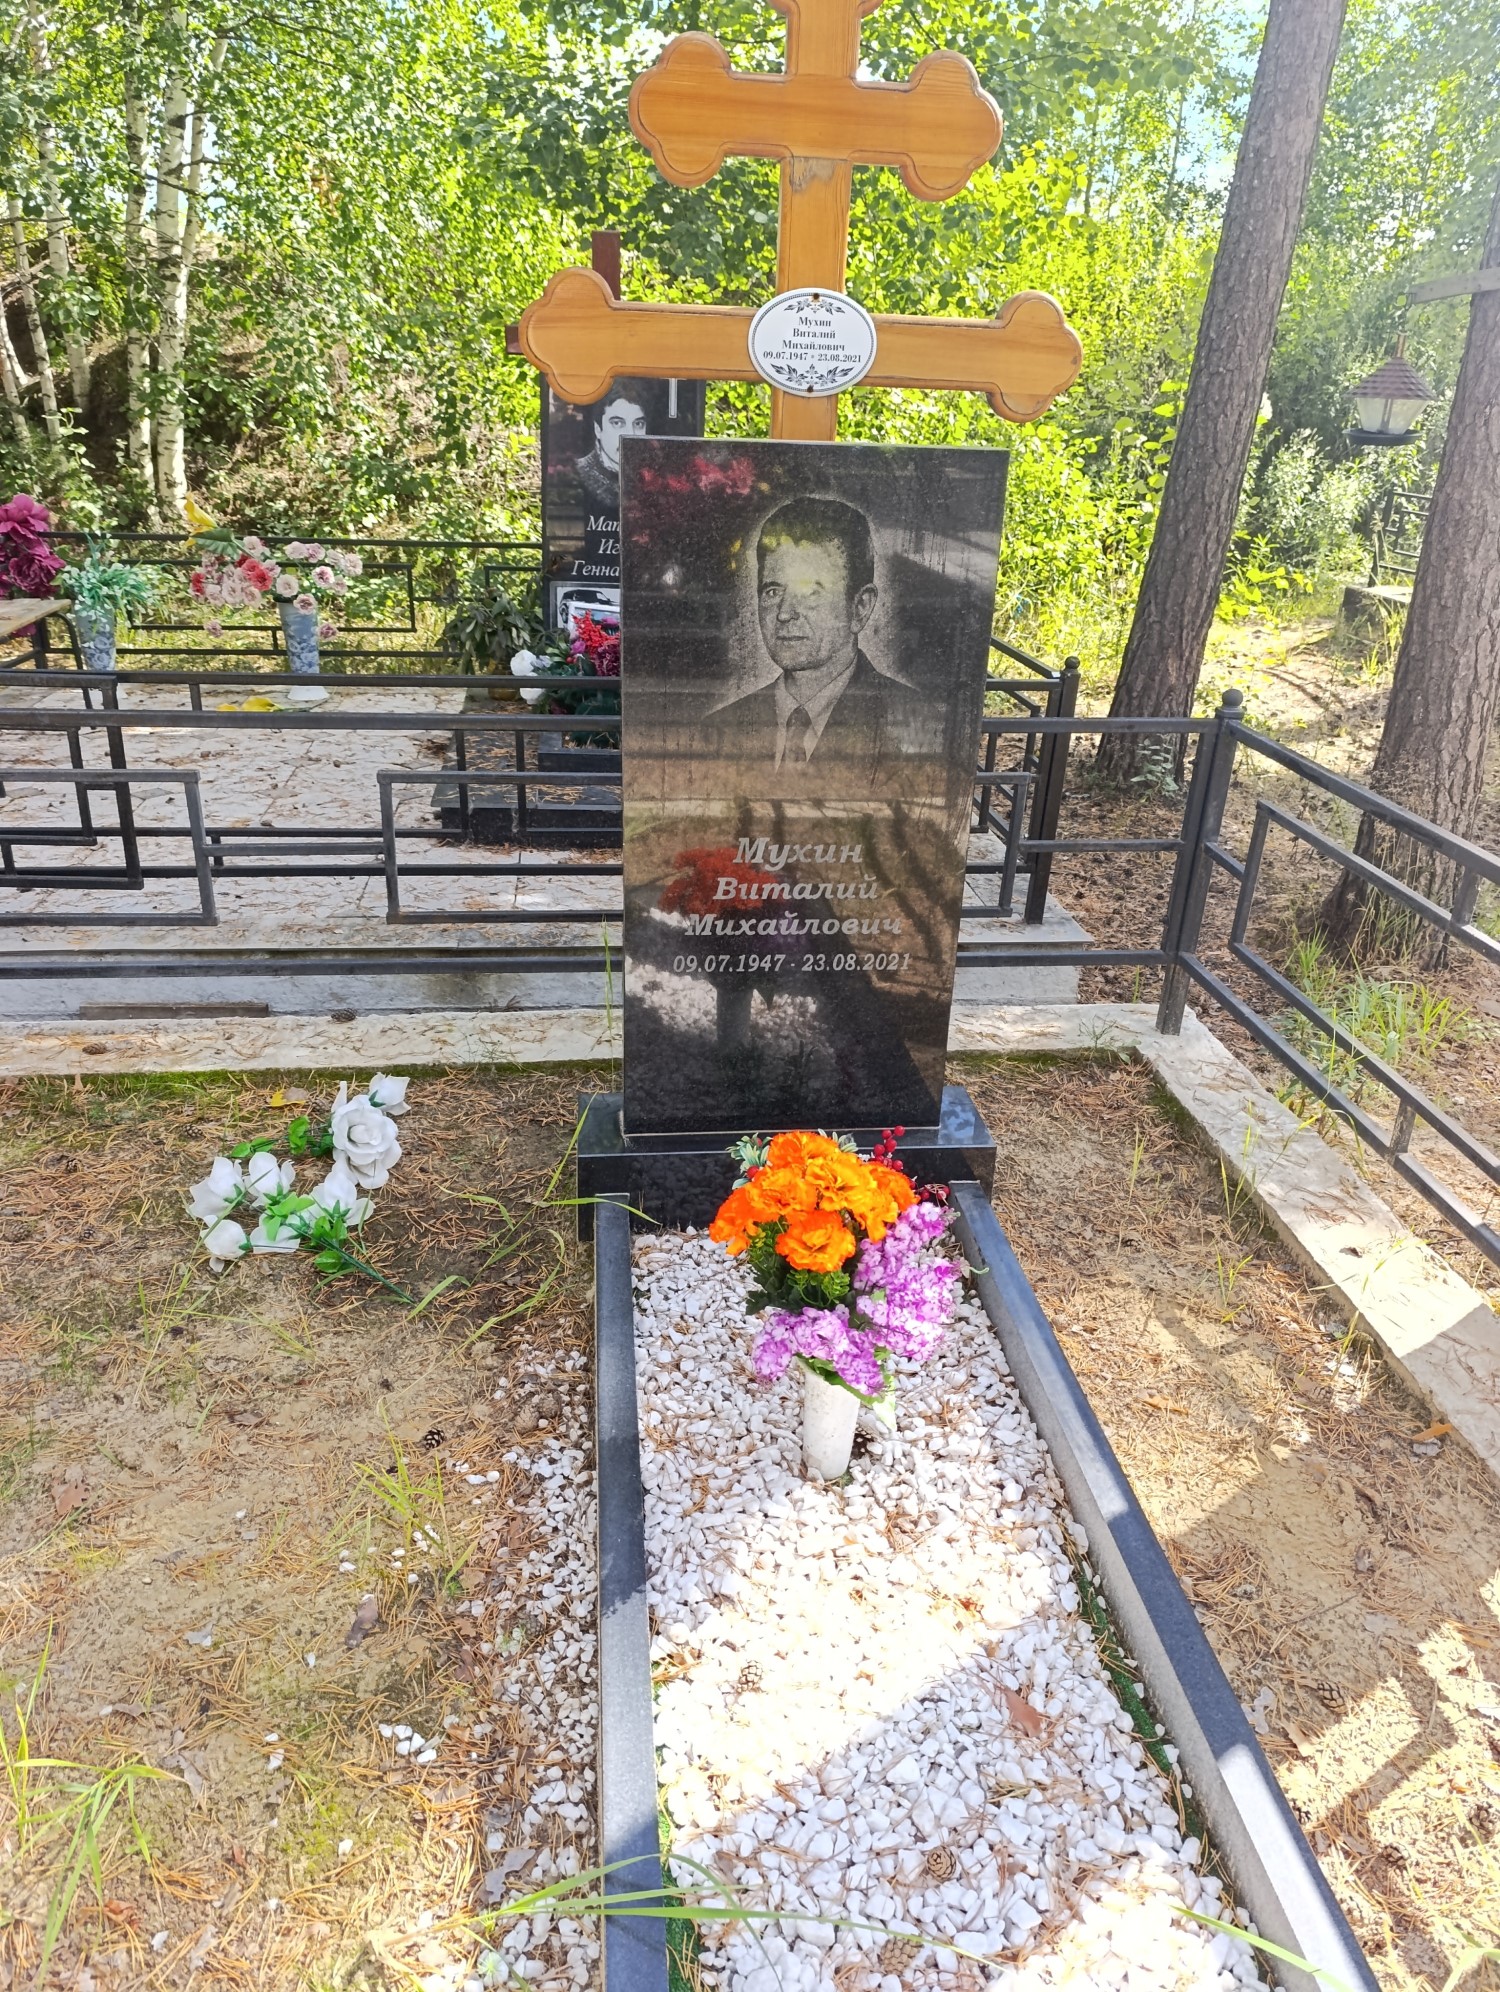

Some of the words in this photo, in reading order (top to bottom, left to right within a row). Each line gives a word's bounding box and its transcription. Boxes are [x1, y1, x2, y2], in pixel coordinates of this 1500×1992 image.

[798, 316, 832, 328] Мухин
[792, 328, 836, 339] Виталий
[782, 340, 845, 351] Михайлович
[763, 351, 808, 360] 09.07.1947
[817, 354, 862, 363] 23.08.2021
[733, 837, 863, 871] Мухин
[713, 875, 877, 900] Виталий
[685, 911, 902, 936] Михайлович
[673, 954, 786, 973] 09.07.1947
[801, 953, 910, 971] 23.08.2021
